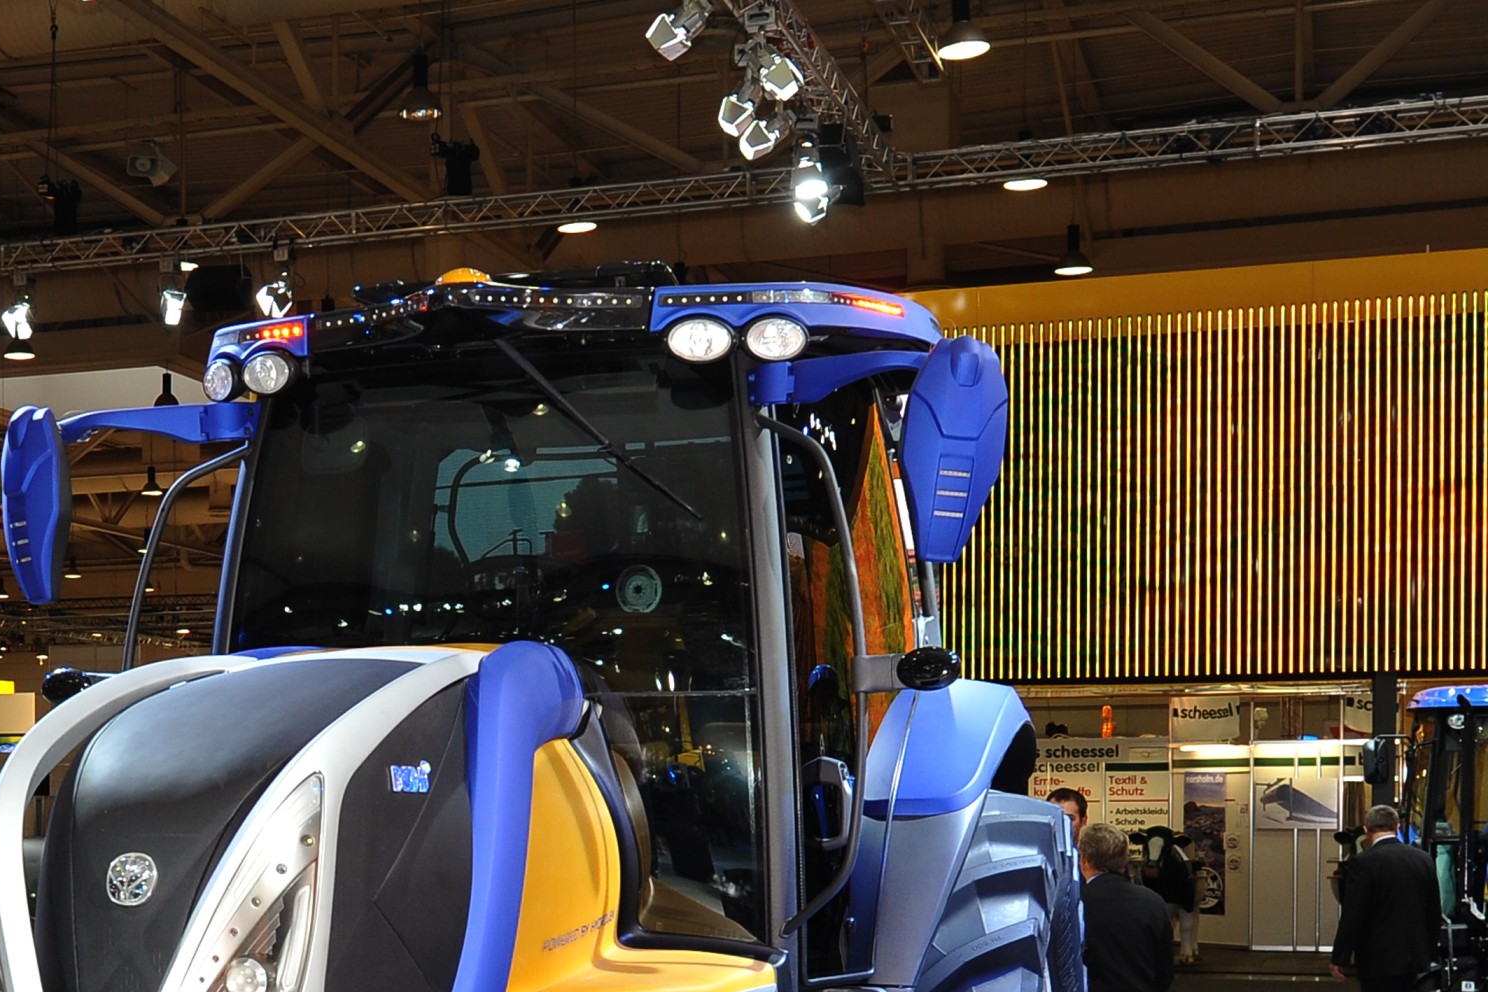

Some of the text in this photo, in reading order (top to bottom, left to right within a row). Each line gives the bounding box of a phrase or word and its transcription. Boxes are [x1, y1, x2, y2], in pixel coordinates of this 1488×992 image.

[1180, 702, 1233, 720] scheessel
[1045, 744, 1119, 758] scheessel
[1108, 775, 1147, 785] Textil &
[1108, 786, 1145, 796] Schutz
